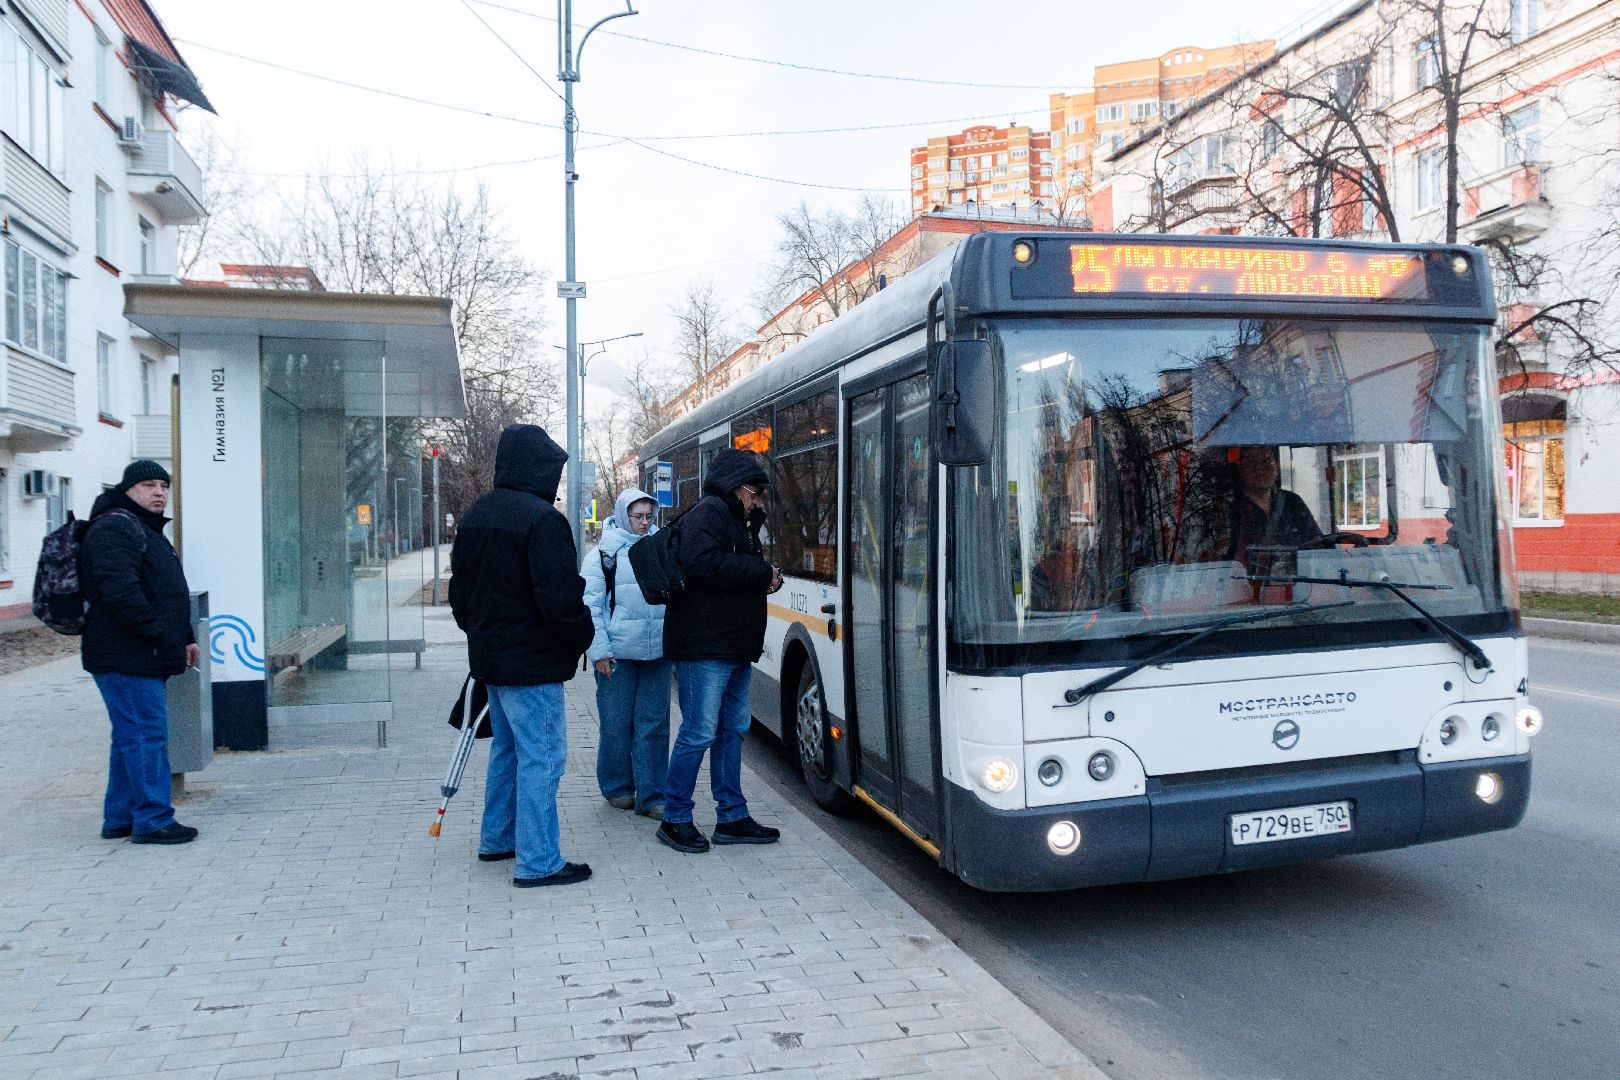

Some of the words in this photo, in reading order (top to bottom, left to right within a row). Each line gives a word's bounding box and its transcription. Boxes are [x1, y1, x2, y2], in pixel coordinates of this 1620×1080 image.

[1327, 254, 1348, 273] 6
[211, 367, 225, 392] №1
[213, 397, 226, 462] Гимназия
[1219, 692, 1357, 714] МОСТРАНСАВТО
[1240, 815, 1314, 841] Р729ВЕ
[1317, 806, 1345, 824] 750
